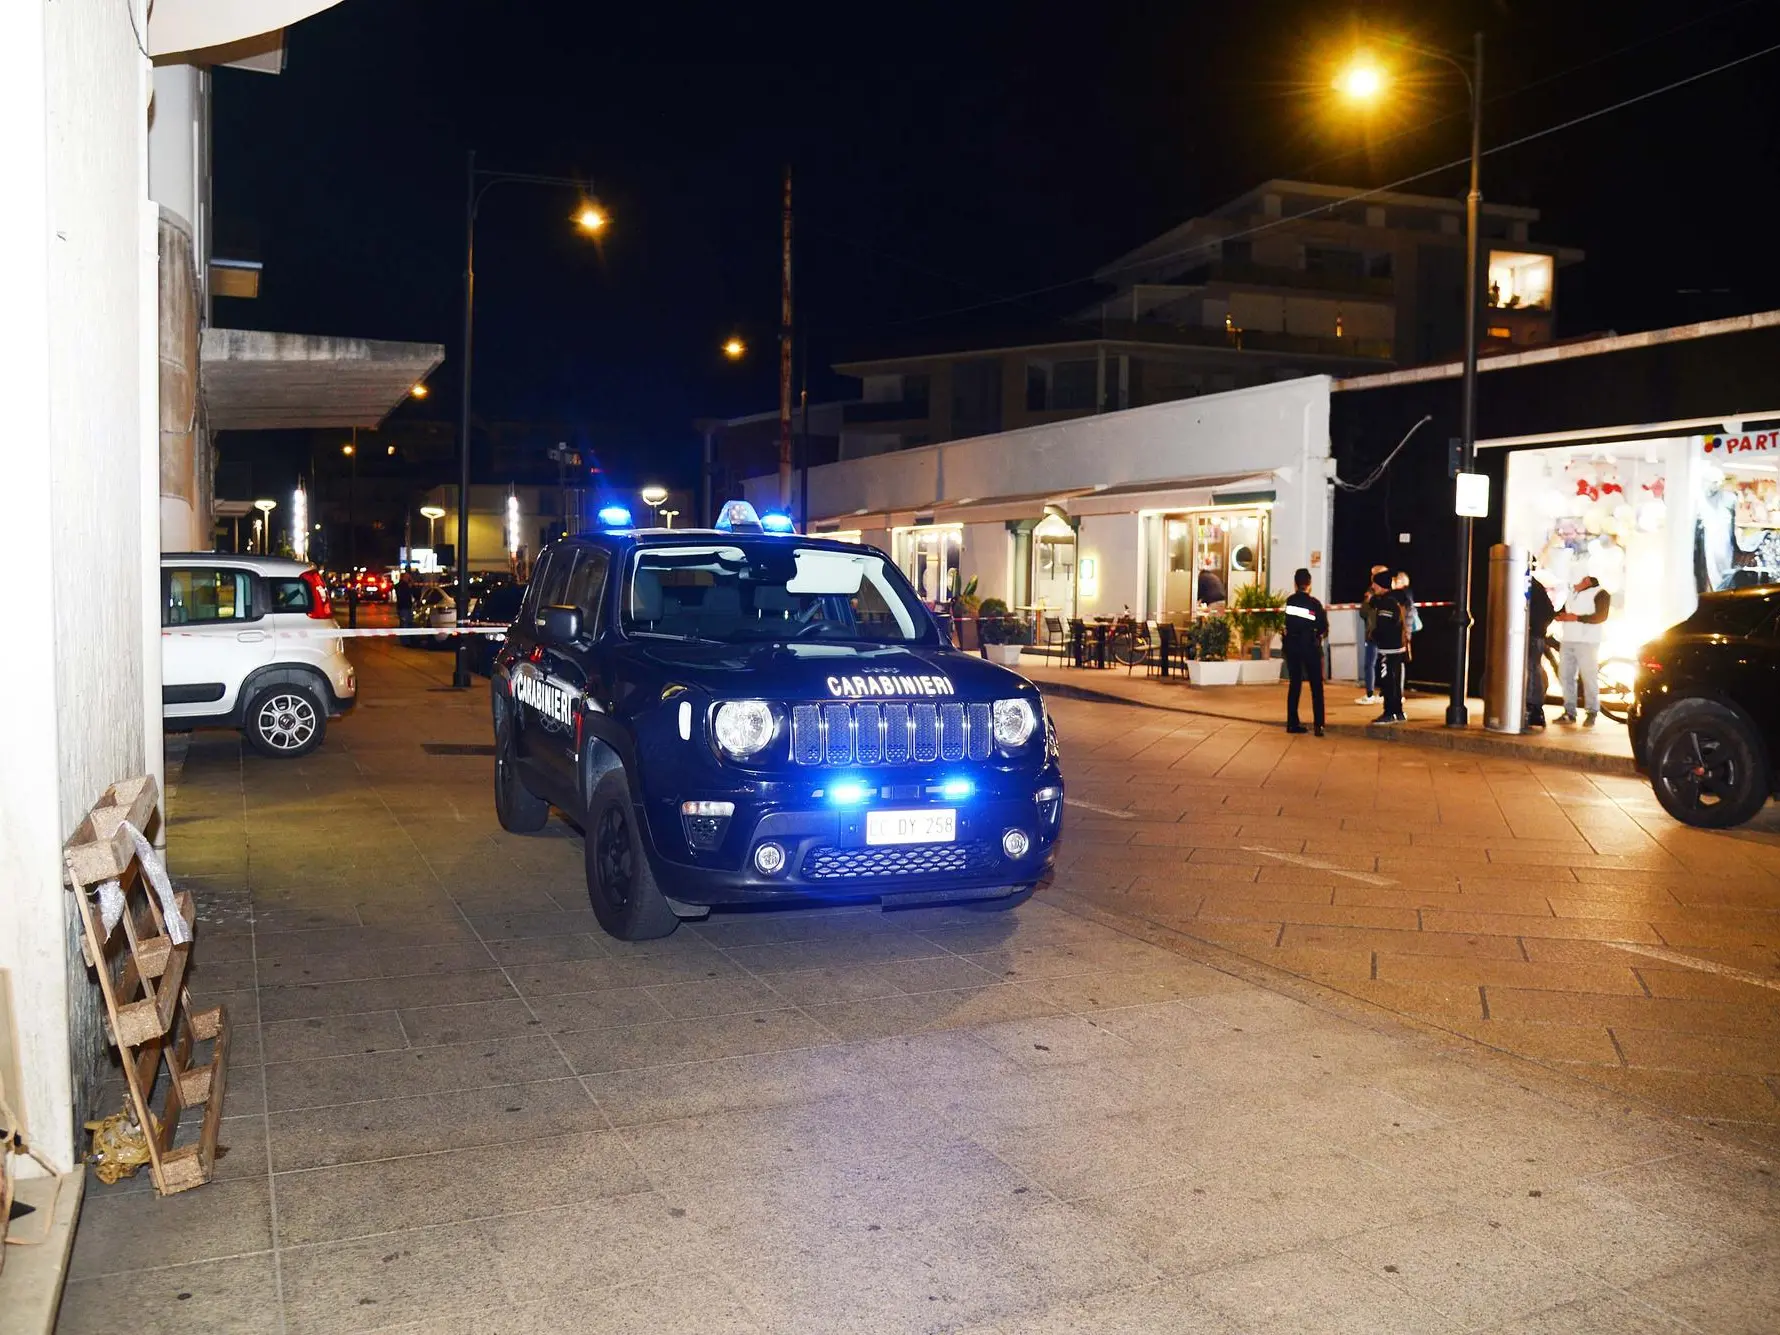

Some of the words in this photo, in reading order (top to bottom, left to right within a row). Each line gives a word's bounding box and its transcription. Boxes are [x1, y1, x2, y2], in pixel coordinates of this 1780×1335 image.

[827, 675, 955, 697] CARABINIERI
[516, 672, 572, 726] CARABINIERI
[898, 817, 916, 836] DY
[925, 816, 953, 835] 258
